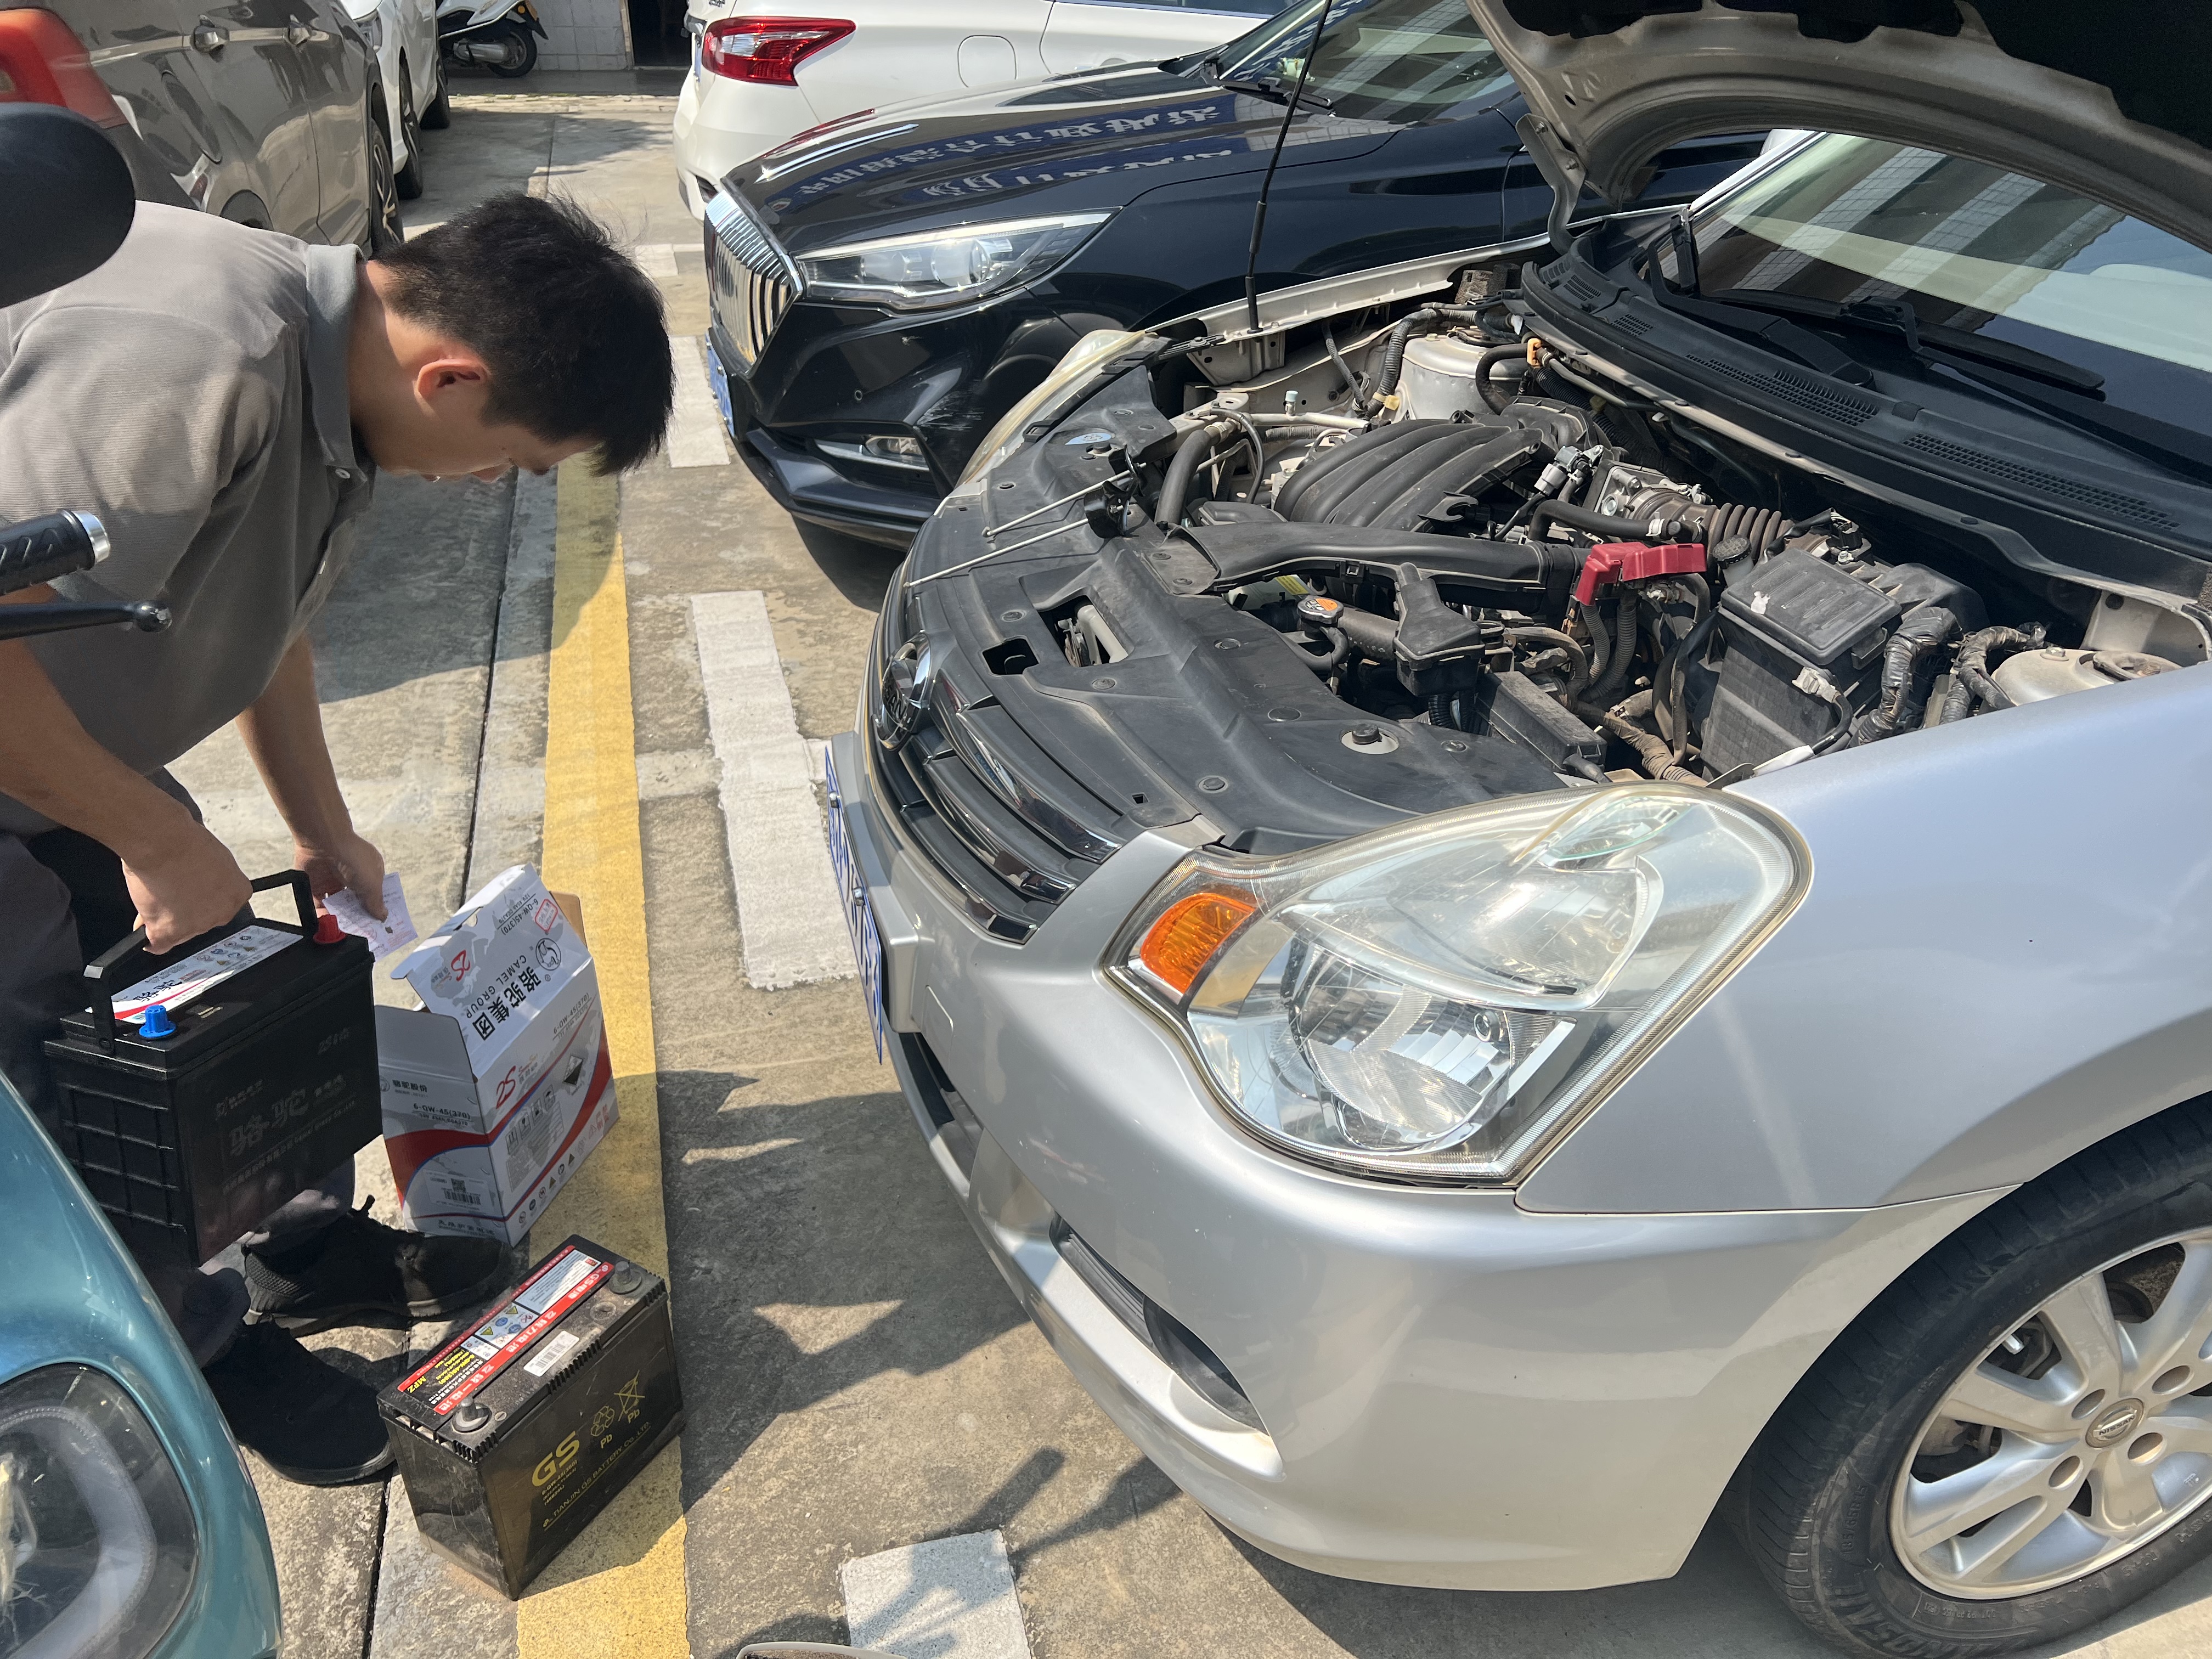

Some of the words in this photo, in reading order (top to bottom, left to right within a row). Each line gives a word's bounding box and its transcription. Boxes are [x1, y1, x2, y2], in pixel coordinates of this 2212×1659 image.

[501, 899, 539, 936] 6-QW-45(370)
[496, 955, 526, 985] CAMEL
[467, 986, 495, 1018] GROUP
[472, 966, 541, 1041] 骆驼集团
[392, 1080, 427, 1093] 骆驼股份
[413, 1103, 470, 1120] 6-QW-45(370)
[627, 1409, 640, 1424] Pb
[2099, 1415, 2135, 1436] NISSAN
[600, 1433, 613, 1449] Pb
[532, 1430, 580, 1487] GS
[553, 1488, 580, 1517] TIANJIN
[581, 1477, 592, 1490] GS
[592, 1446, 623, 1479] BATTERY
